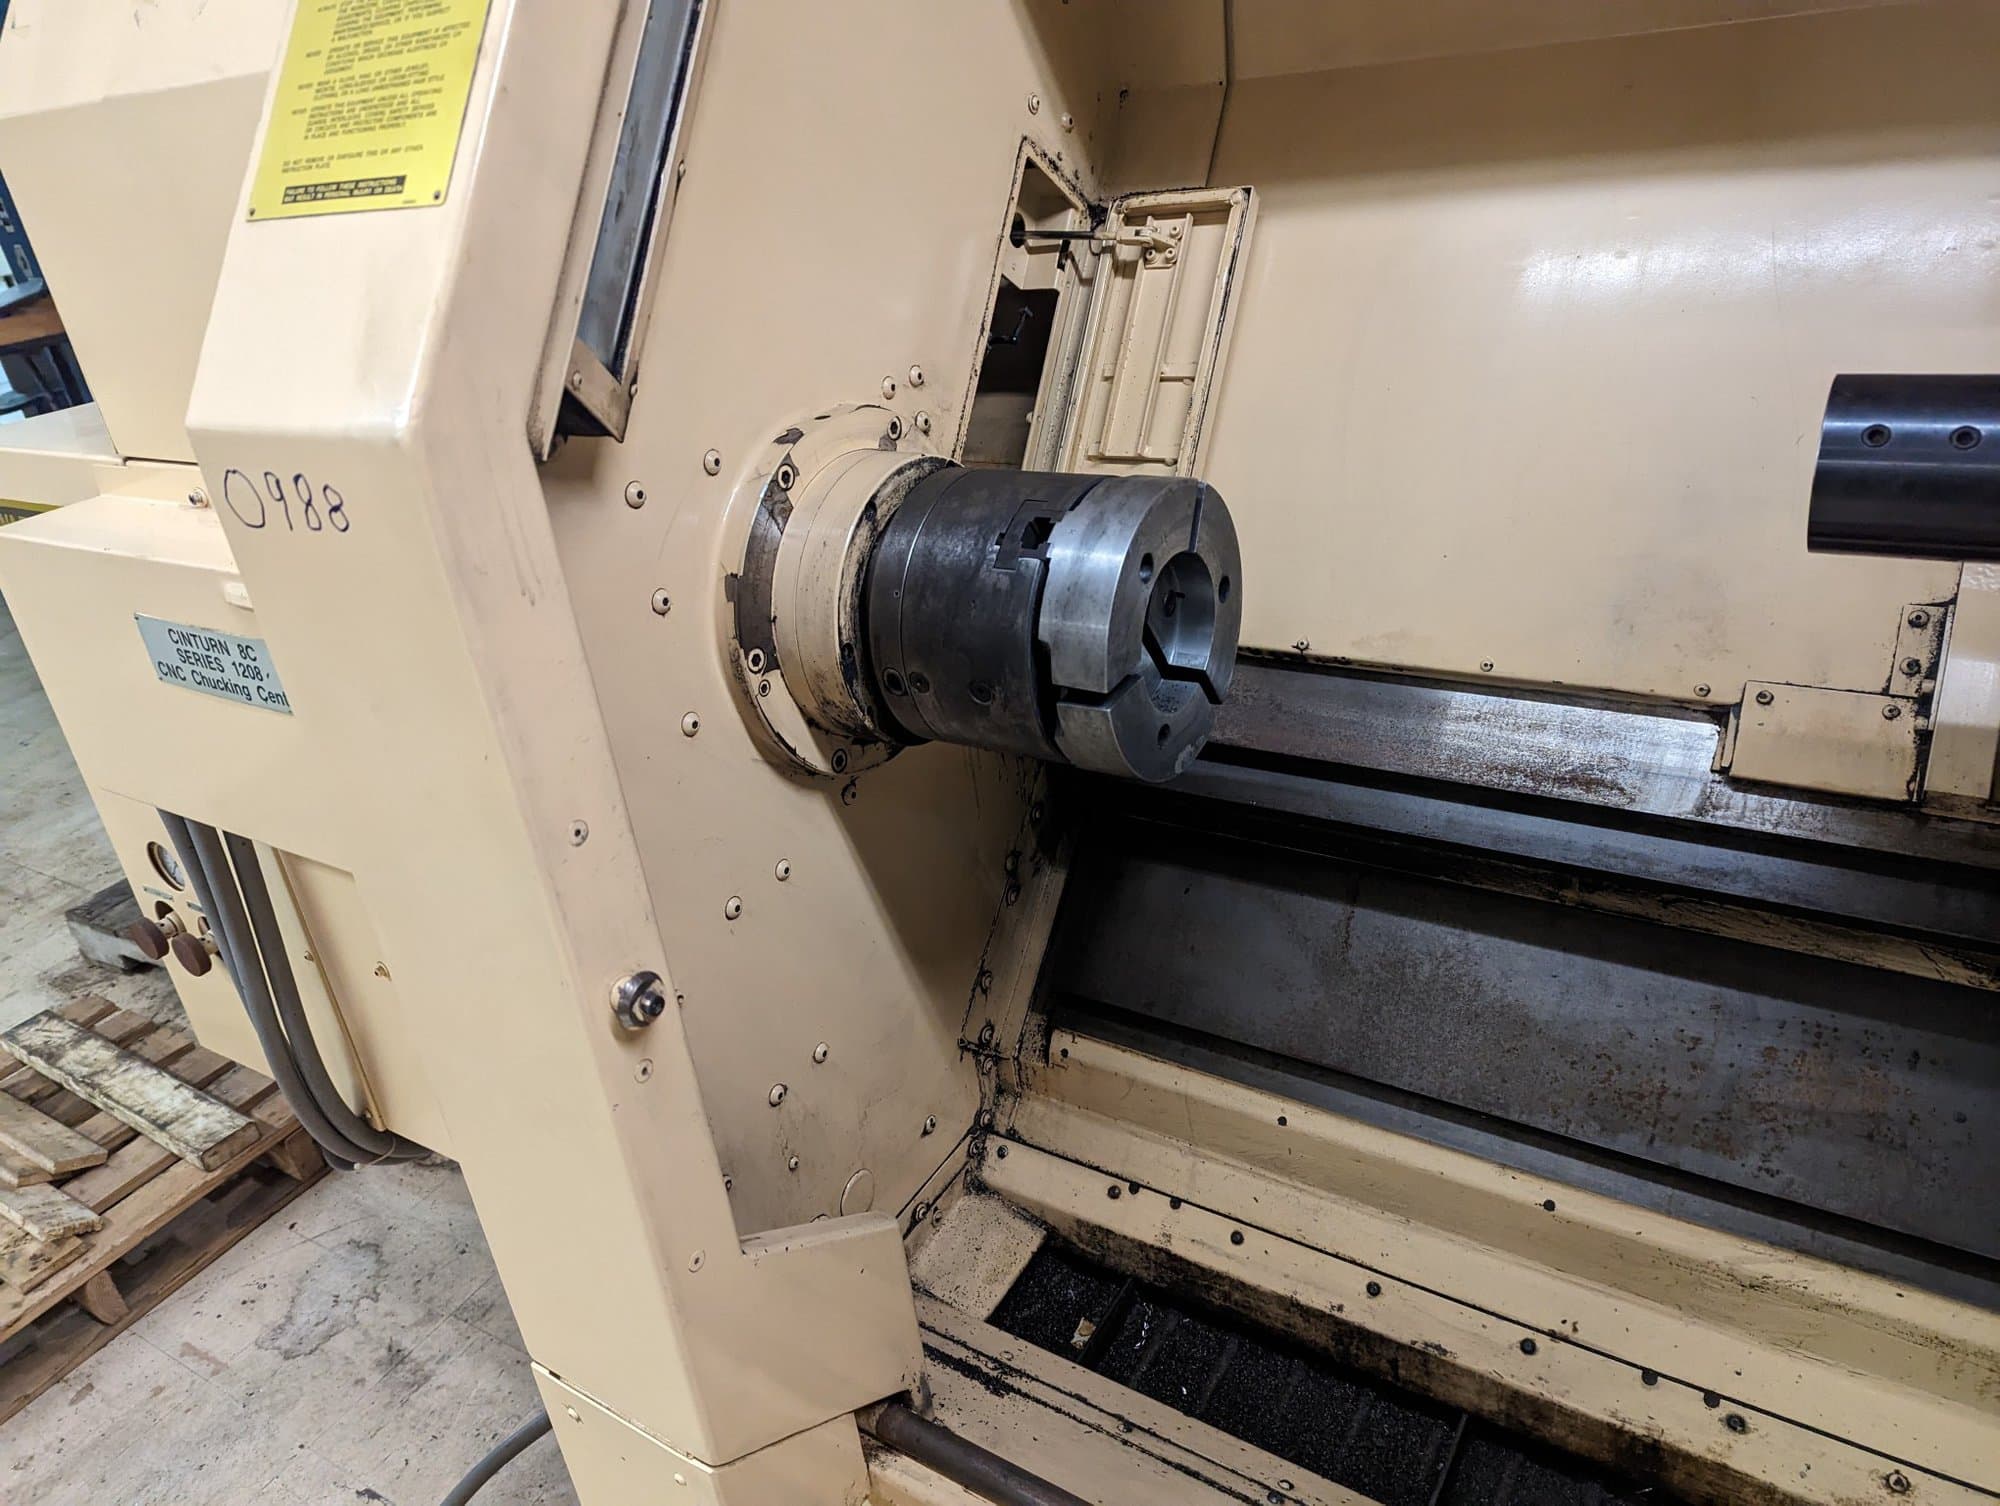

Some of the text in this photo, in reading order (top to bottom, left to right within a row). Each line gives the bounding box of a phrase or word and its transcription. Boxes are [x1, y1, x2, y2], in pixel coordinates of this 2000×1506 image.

[224, 469, 350, 532] 0988
[168, 628, 257, 662] CINTURN 8C
[158, 661, 186, 681] CNC
[191, 670, 252, 701] Chucking
[176, 648, 264, 682] SERIES 1208
